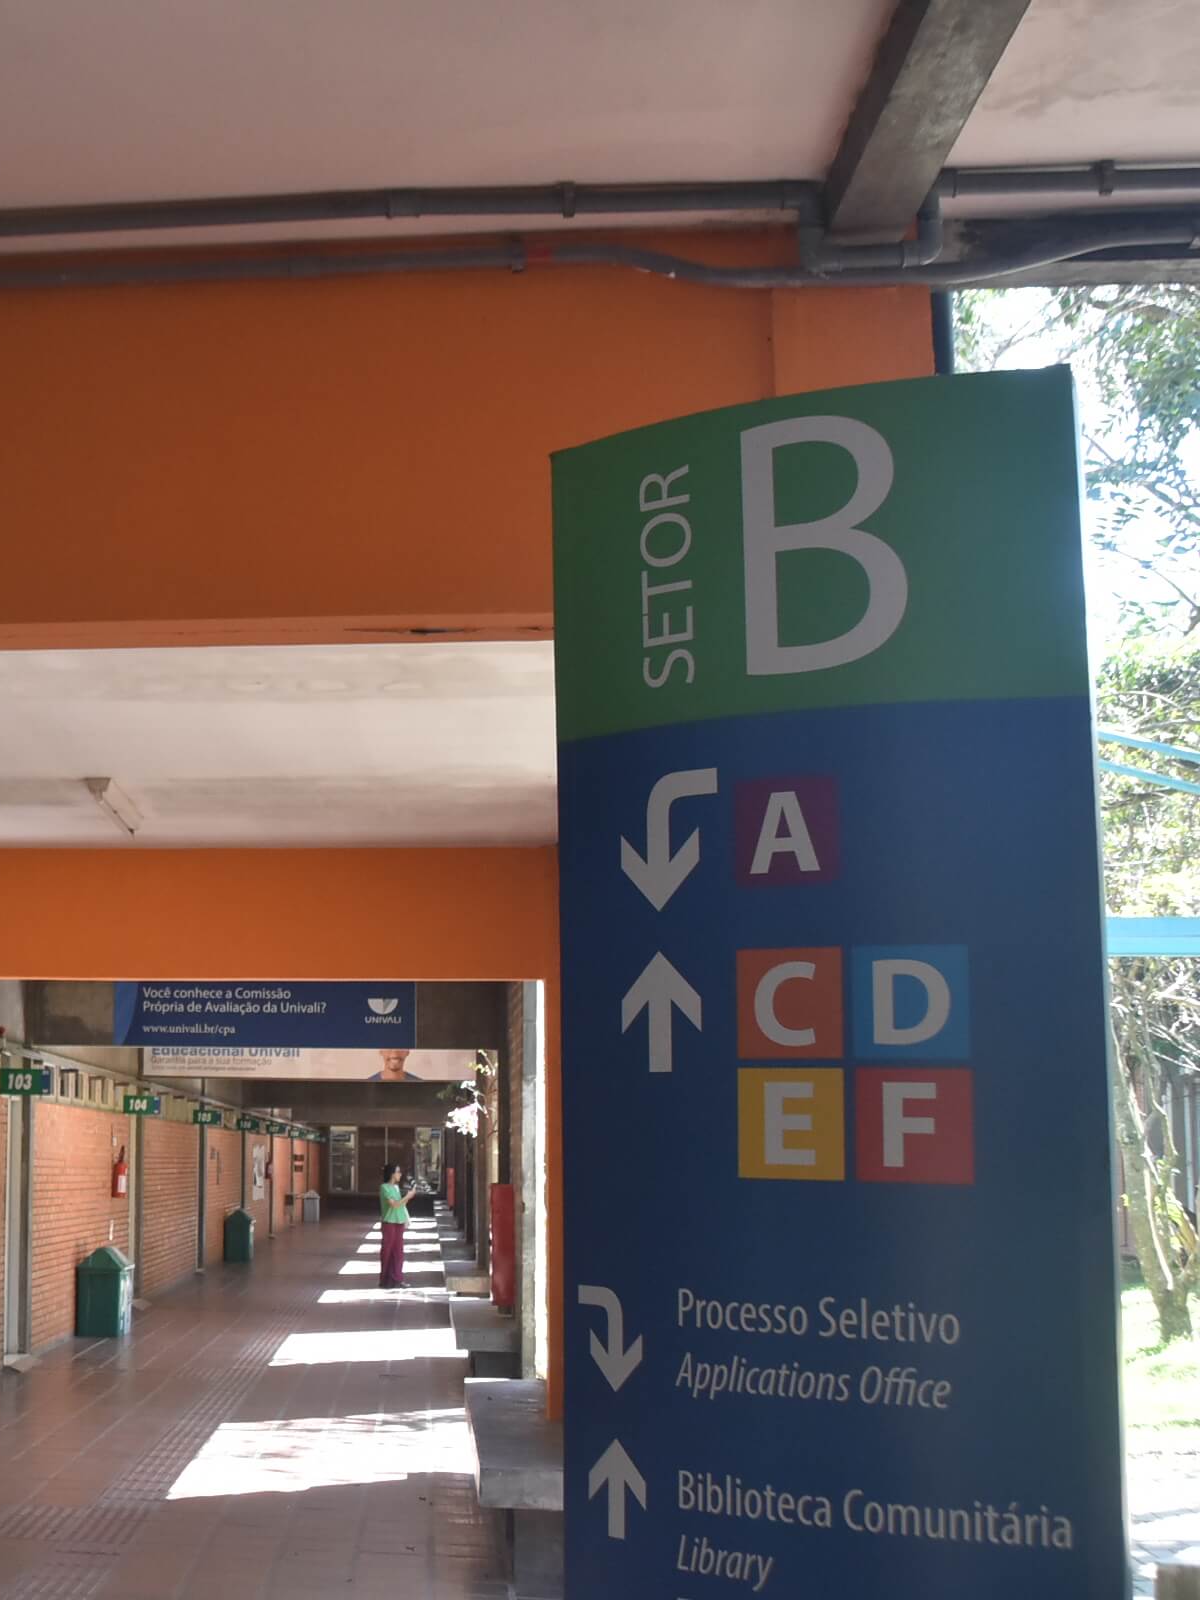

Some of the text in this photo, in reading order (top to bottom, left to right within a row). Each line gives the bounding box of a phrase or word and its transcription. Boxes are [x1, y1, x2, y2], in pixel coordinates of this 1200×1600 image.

[740, 415, 908, 676] B
[639, 464, 695, 689] SETOR
[749, 791, 820, 875] A
[142, 986, 291, 1000] Você conhece a Comissão
[143, 1001, 327, 1015] Própria de Avaliação da Univali?
[364, 1015, 402, 1024] UNIVALI
[754, 959, 951, 1047] C D
[143, 1023, 236, 1036] www.univali.br/cpa
[7, 1073, 32, 1091] 103
[129, 1098, 148, 1111] 104
[764, 1081, 937, 1168] E F
[677, 1288, 961, 1345] Processo Seletivo
[675, 1352, 952, 1410] Applications Office
[677, 1470, 1074, 1550] Biblioteca Comunitária
[676, 1534, 774, 1591] Library
